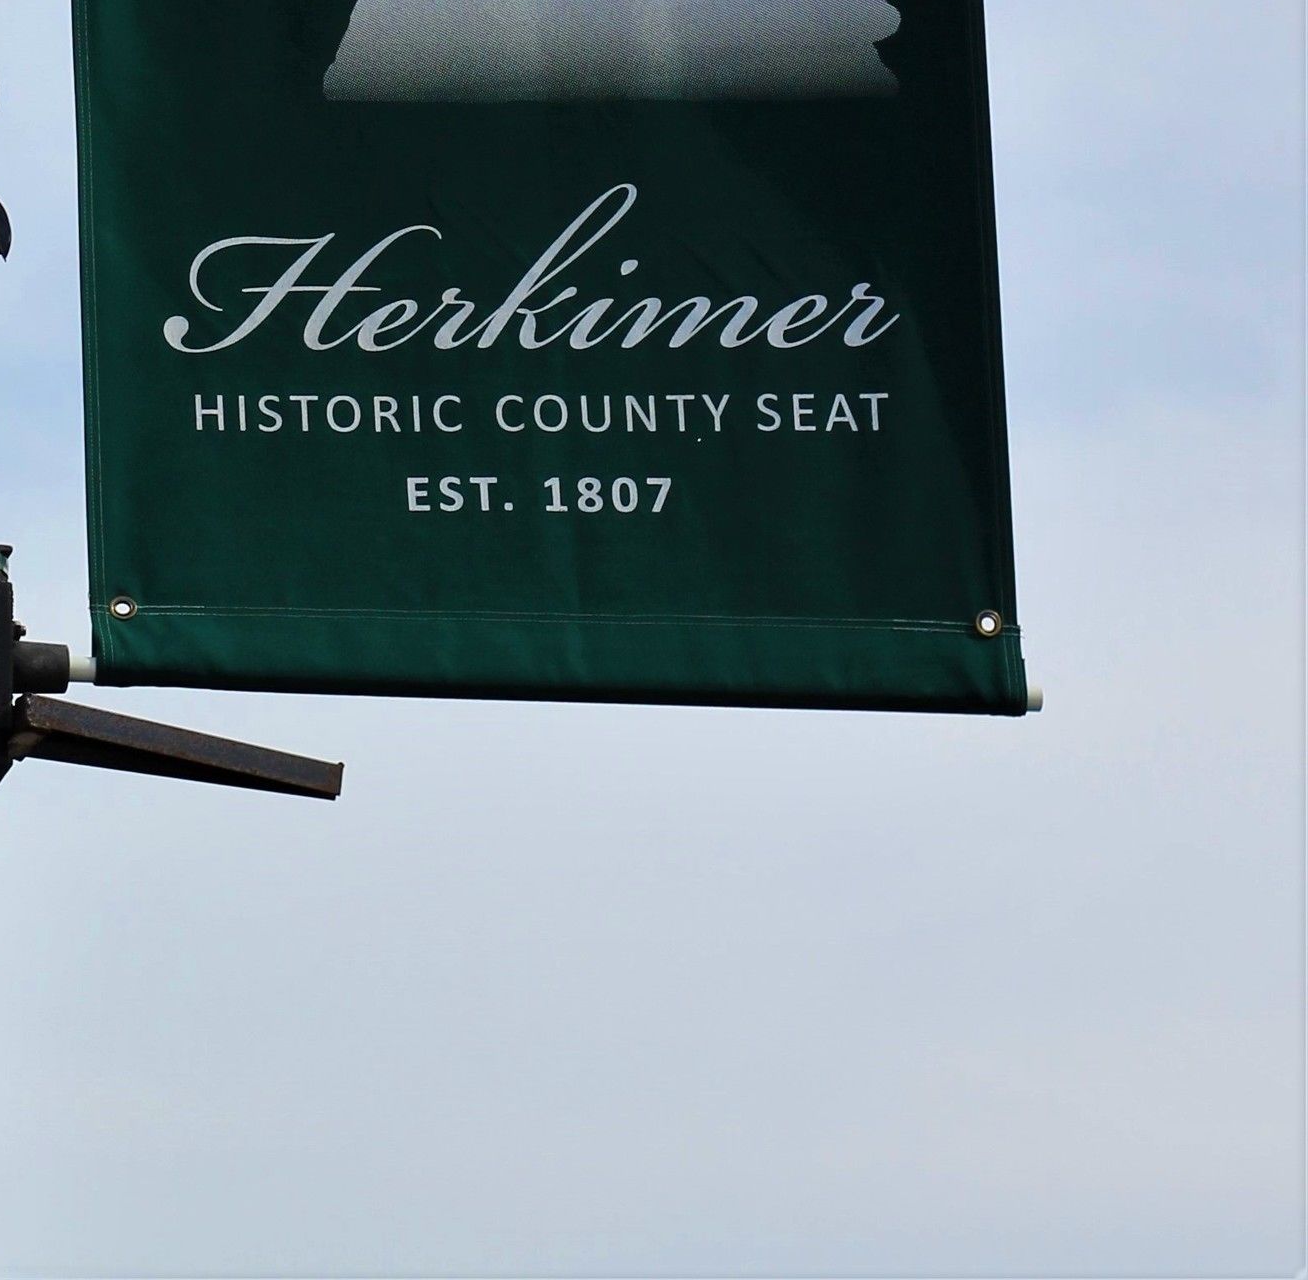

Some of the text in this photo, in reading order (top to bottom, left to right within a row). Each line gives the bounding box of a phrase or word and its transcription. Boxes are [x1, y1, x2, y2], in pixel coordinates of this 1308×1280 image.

[162, 183, 901, 354] Herkimer
[194, 392, 890, 433] HISTORIC COUNTY SEAT
[406, 476, 673, 513] EST. 1807
